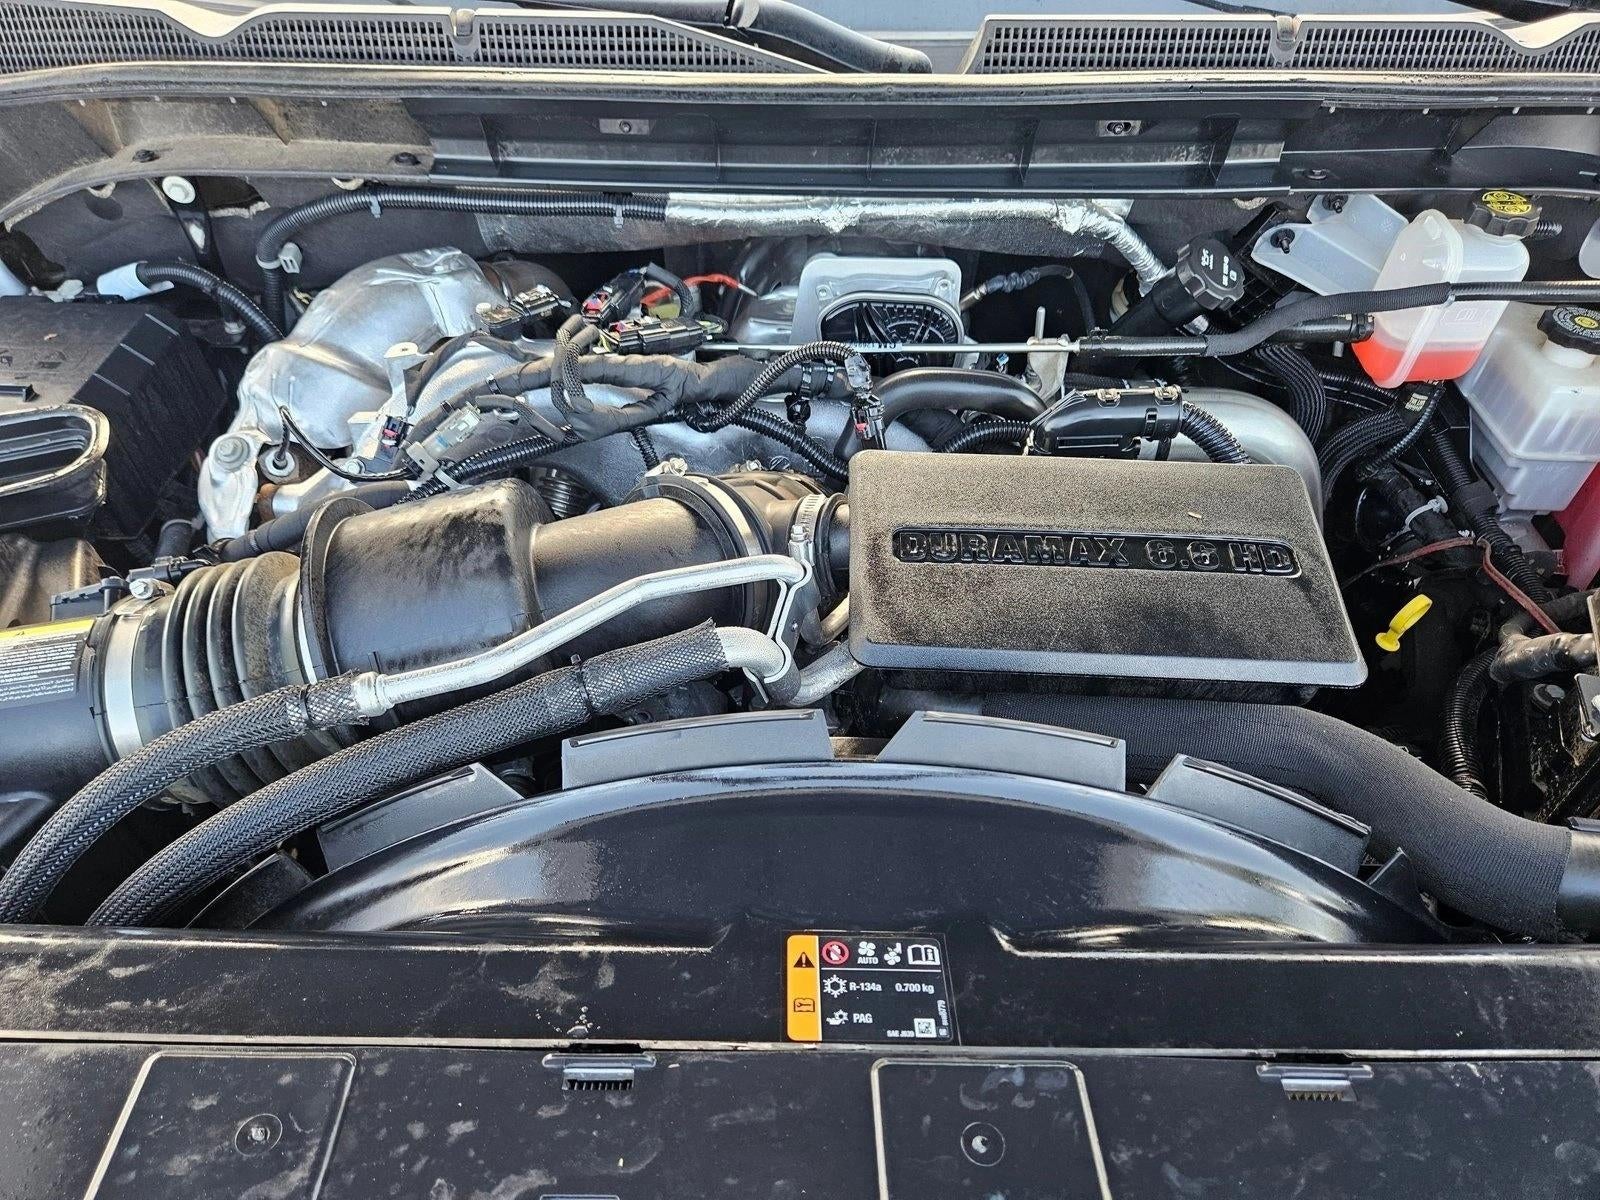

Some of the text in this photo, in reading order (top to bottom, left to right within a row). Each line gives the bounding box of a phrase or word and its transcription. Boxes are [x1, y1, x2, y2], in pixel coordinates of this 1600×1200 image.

[899, 532, 1296, 574] DURAMAX 6.6 HD
[857, 956, 879, 965] AUTO
[849, 982, 935, 994] R-134a 0.700 kg
[852, 1013, 873, 1023] PAG
